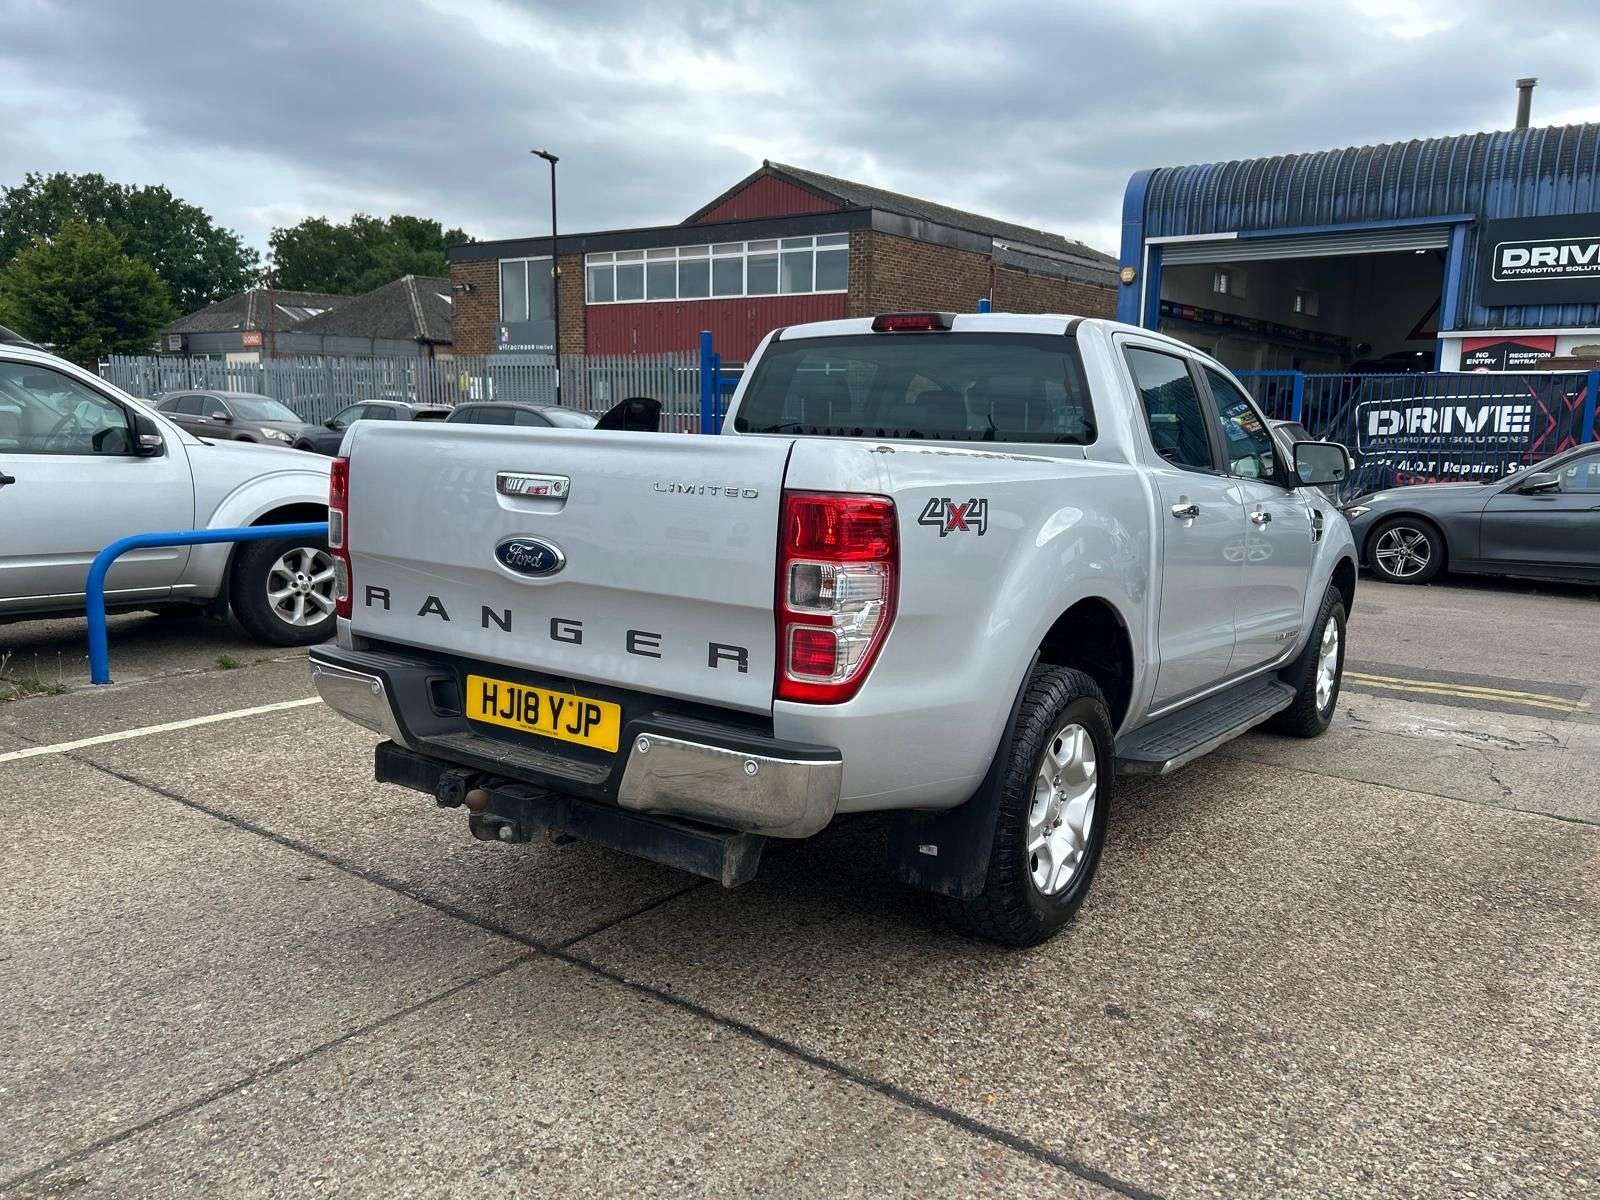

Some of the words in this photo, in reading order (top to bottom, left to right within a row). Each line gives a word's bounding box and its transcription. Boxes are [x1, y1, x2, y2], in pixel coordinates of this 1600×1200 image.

[1502, 244, 1600, 268] DRIV
[1502, 266, 1563, 275] AUTOMOTIVE
[1368, 406, 1531, 436] DRIVE
[1443, 461, 1499, 475] Repairs
[653, 482, 760, 499] LIMITED
[506, 543, 543, 567] Ford
[365, 584, 749, 674] RANGER
[482, 682, 540, 725] HJ18
[548, 695, 602, 738] YJP
